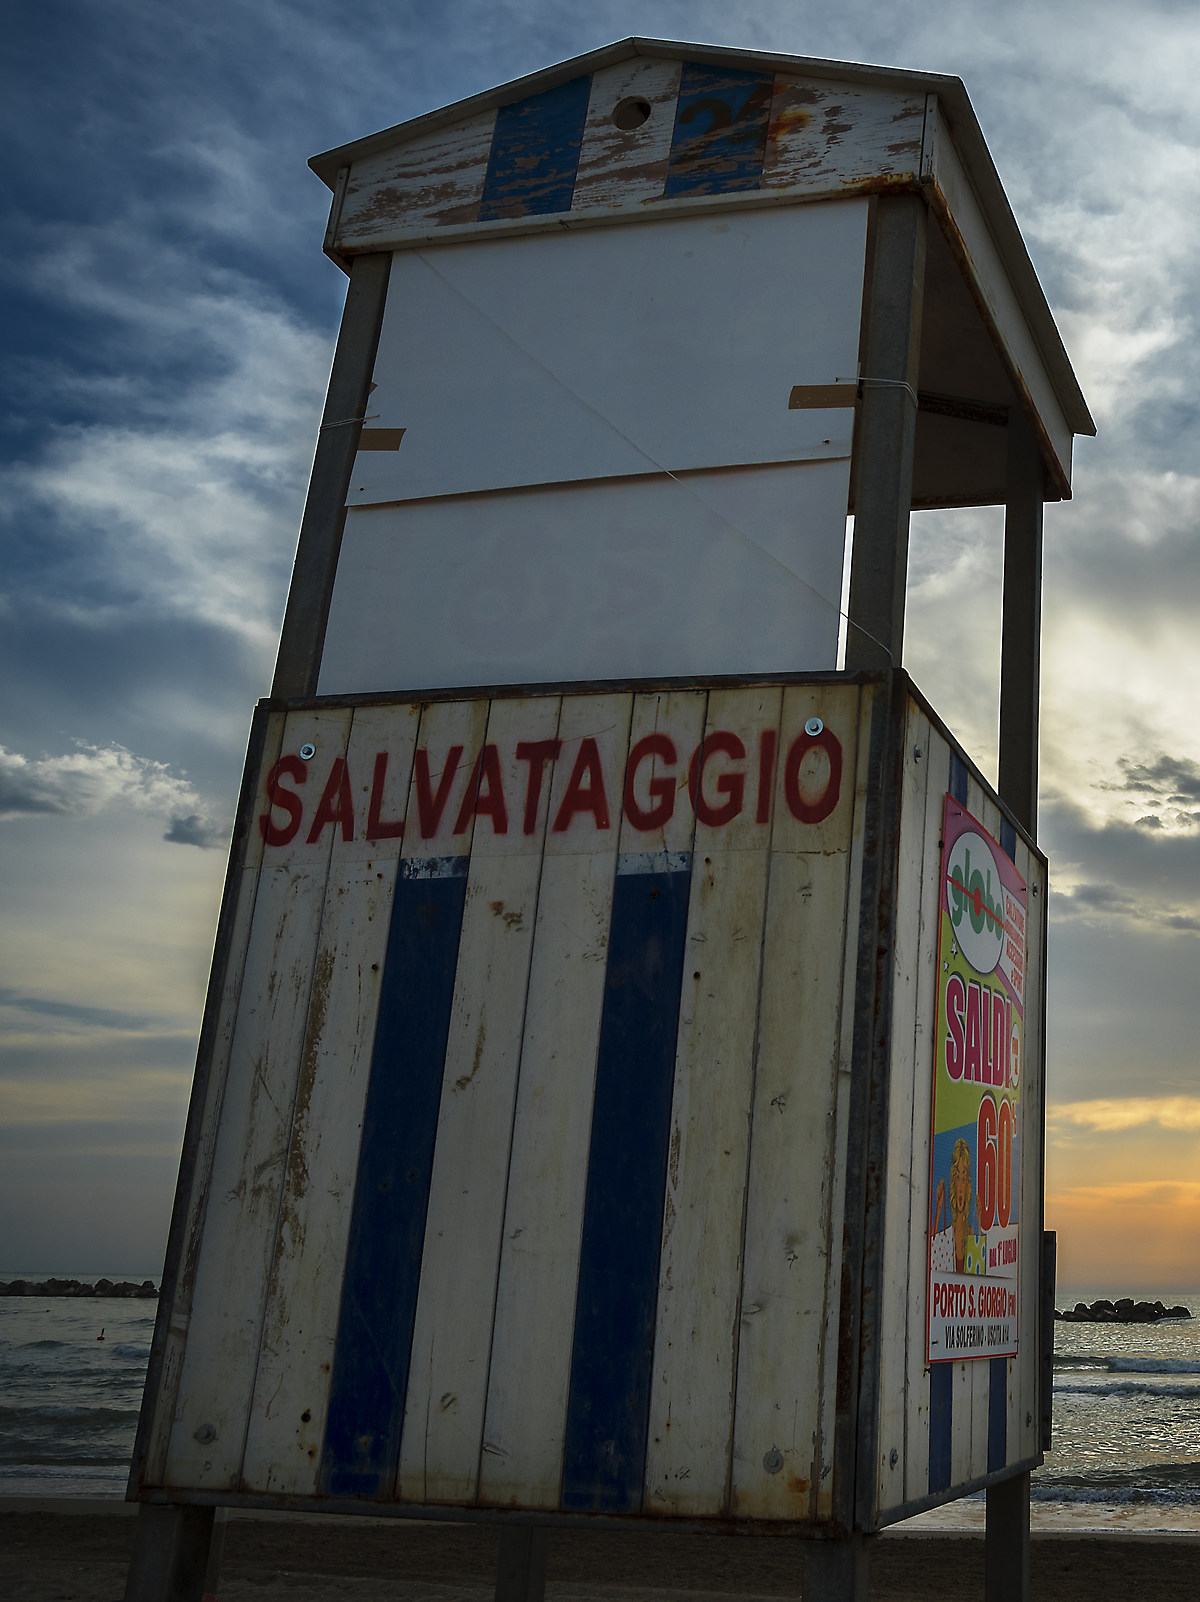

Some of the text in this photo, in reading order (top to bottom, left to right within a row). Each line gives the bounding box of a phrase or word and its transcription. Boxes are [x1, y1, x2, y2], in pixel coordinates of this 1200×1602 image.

[259, 727, 843, 847] SALVATAGGIO
[951, 848, 1003, 940] globo
[945, 977, 1011, 1089] SALDI
[933, 1282, 967, 1318] PORTO
[968, 1285, 976, 1318] S.
[978, 1285, 1007, 1318] GIORGIO
[945, 1326, 955, 1349] VIA
[956, 1324, 984, 1348] SOLFERINO
